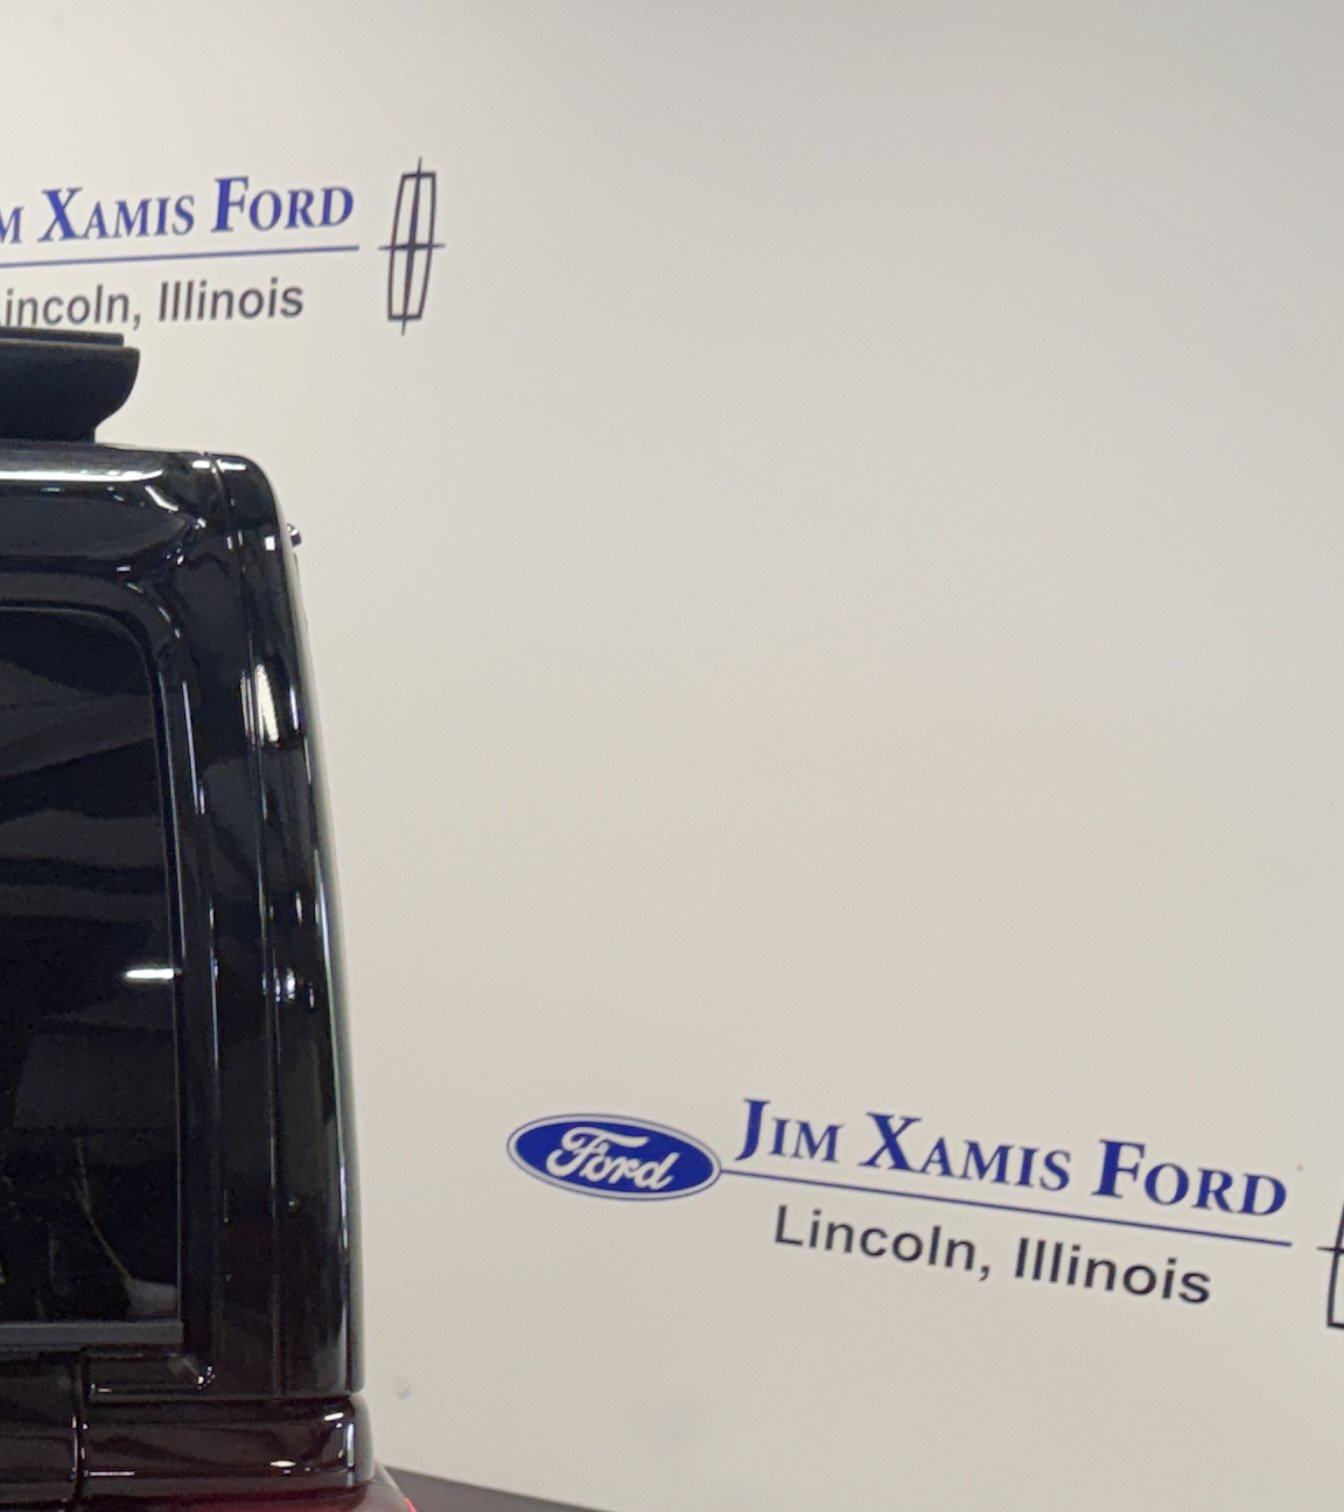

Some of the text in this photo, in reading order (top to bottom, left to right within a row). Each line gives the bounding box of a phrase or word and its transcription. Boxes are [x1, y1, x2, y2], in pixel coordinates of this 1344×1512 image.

[36, 187, 195, 244] XAMIS
[211, 176, 354, 233] FORD
[158, 276, 305, 323] Illinois
[544, 1121, 676, 1192] Ford
[735, 1098, 1288, 1218] JIM XAMIS FORD
[773, 1205, 1214, 1304] Lincoln, Illinois
